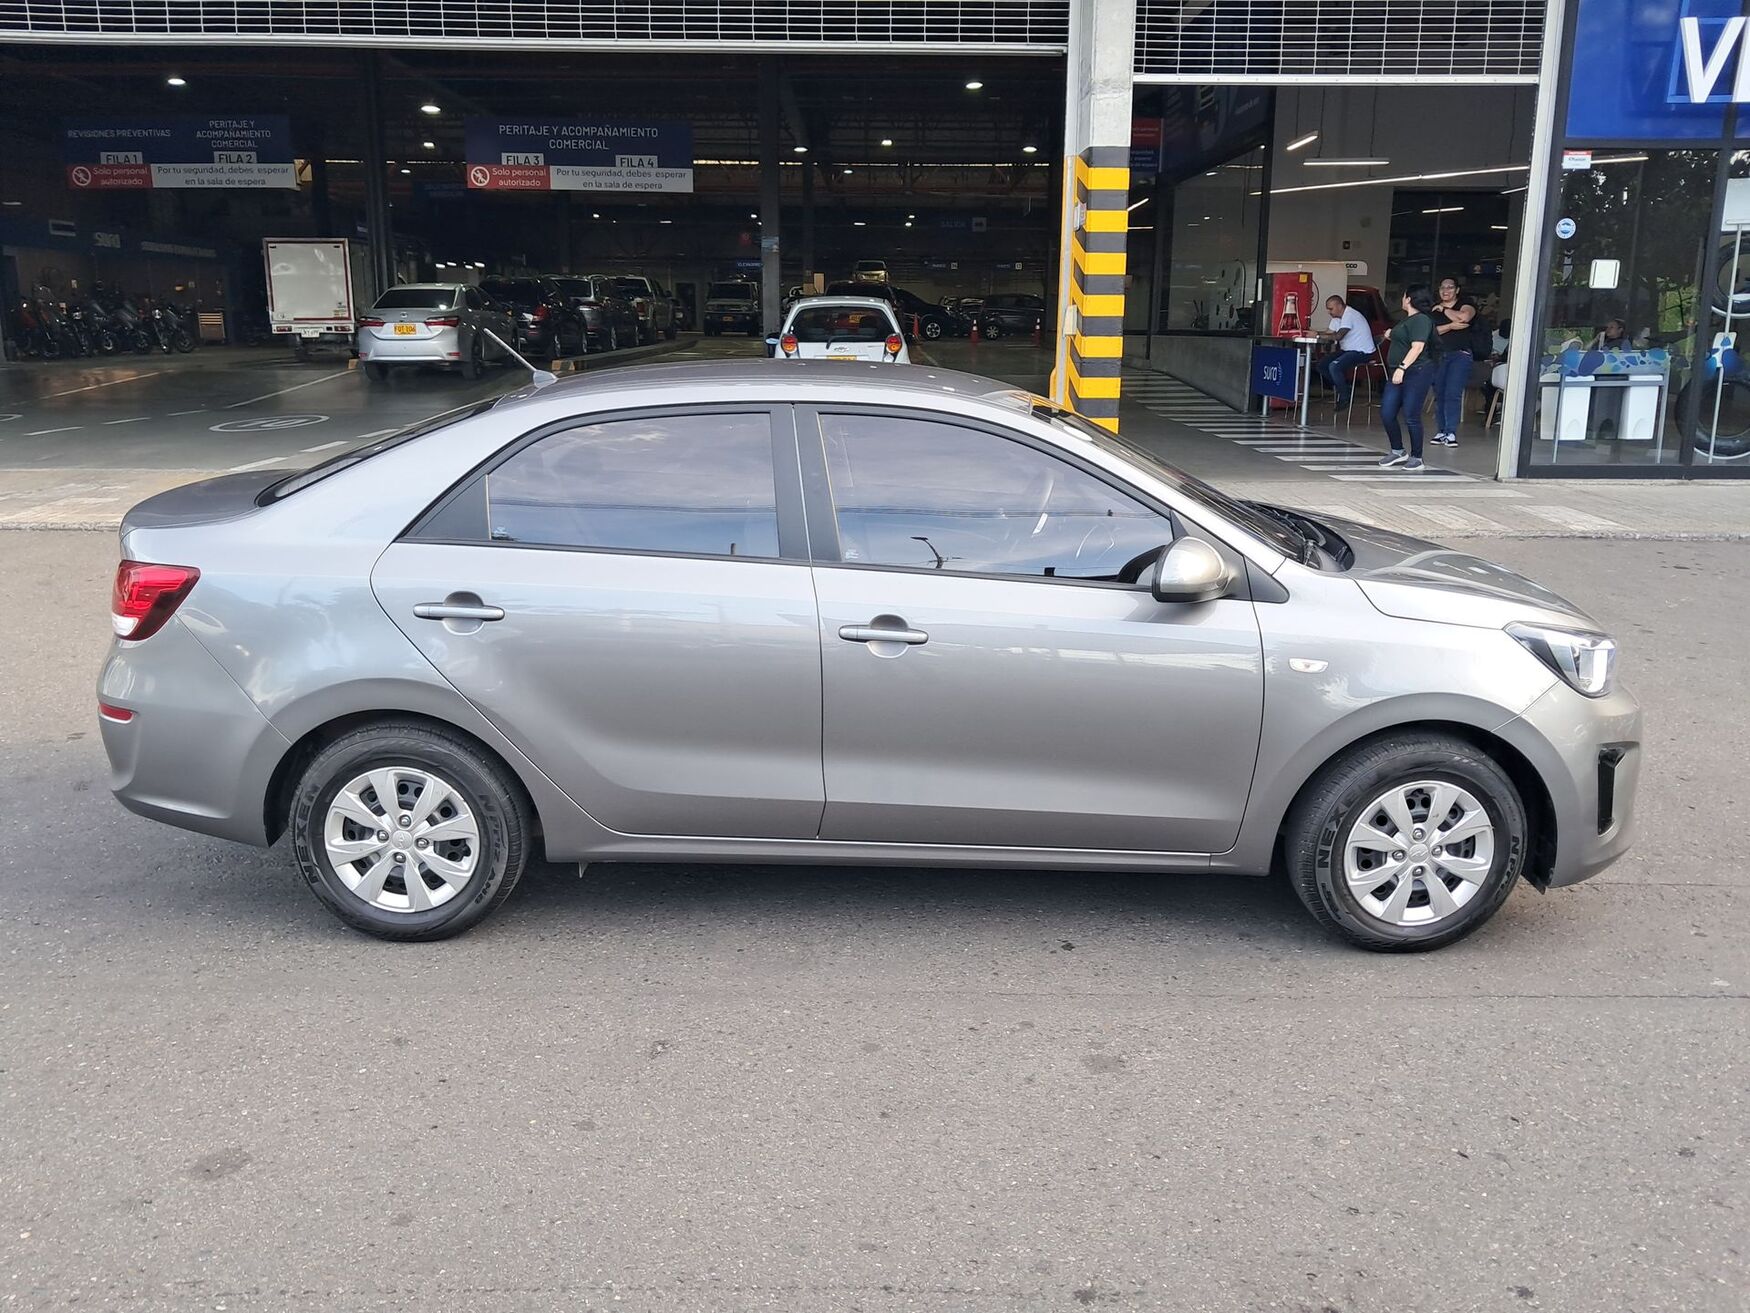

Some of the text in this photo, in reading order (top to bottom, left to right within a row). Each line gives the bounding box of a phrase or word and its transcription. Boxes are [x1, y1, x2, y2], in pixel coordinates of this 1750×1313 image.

[209, 120, 255, 129] PERITAJE Y
[67, 129, 171, 138] REVISIONES PREVENTIVAS
[499, 125, 659, 137] PERITAJE Y ACOMPAÑAMIENTO
[211, 140, 258, 148] COMERCIAL
[549, 139, 609, 150] COMERCIAL
[106, 155, 131, 164] FILA
[218, 154, 252, 164] FILA 2
[506, 155, 540, 165] FILA 3
[620, 157, 654, 168] FILA 4
[92, 167, 148, 177] Solo personal
[157, 166, 172, 174] Por
[228, 166, 254, 174] debes
[257, 167, 289, 176] esperar
[492, 167, 546, 178] Solo personal
[556, 168, 570, 176] Por
[626, 169, 652, 178] debes
[655, 171, 687, 180] esperar
[237, 179, 266, 187] espera
[498, 179, 541, 187] autorizado
[595, 180, 603, 188] la
[603, 180, 621, 188] sala
[622, 180, 633, 189] de
[634, 182, 663, 191] espera
[1263, 365, 1277, 381] sura
[296, 784, 321, 884] NEXEN
